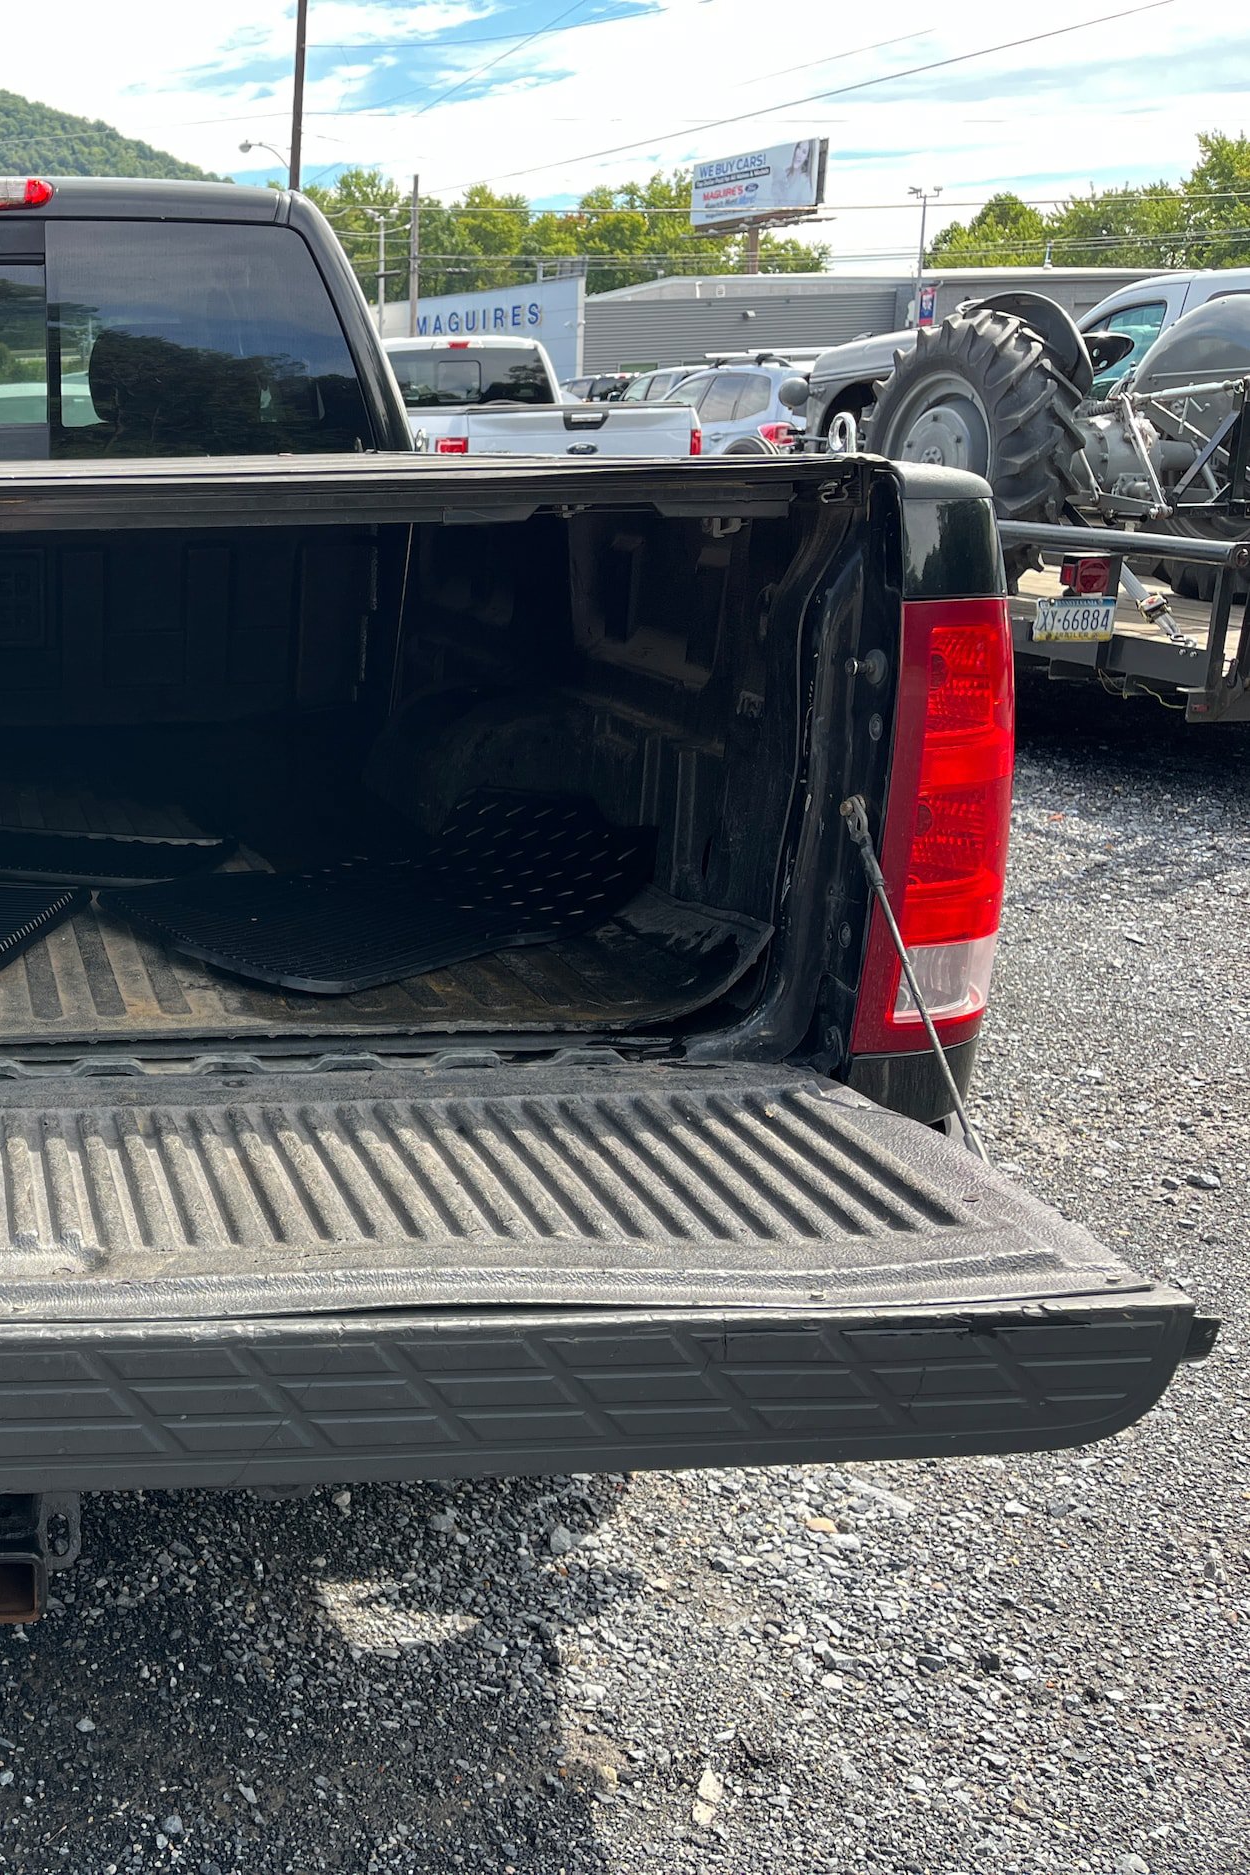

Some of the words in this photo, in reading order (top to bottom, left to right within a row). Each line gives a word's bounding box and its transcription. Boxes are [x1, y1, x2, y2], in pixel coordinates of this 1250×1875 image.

[700, 164, 714, 178] WE
[715, 161, 736, 175] BUY
[736, 154, 767, 171] CARS!
[417, 303, 540, 335] MAGUIRES
